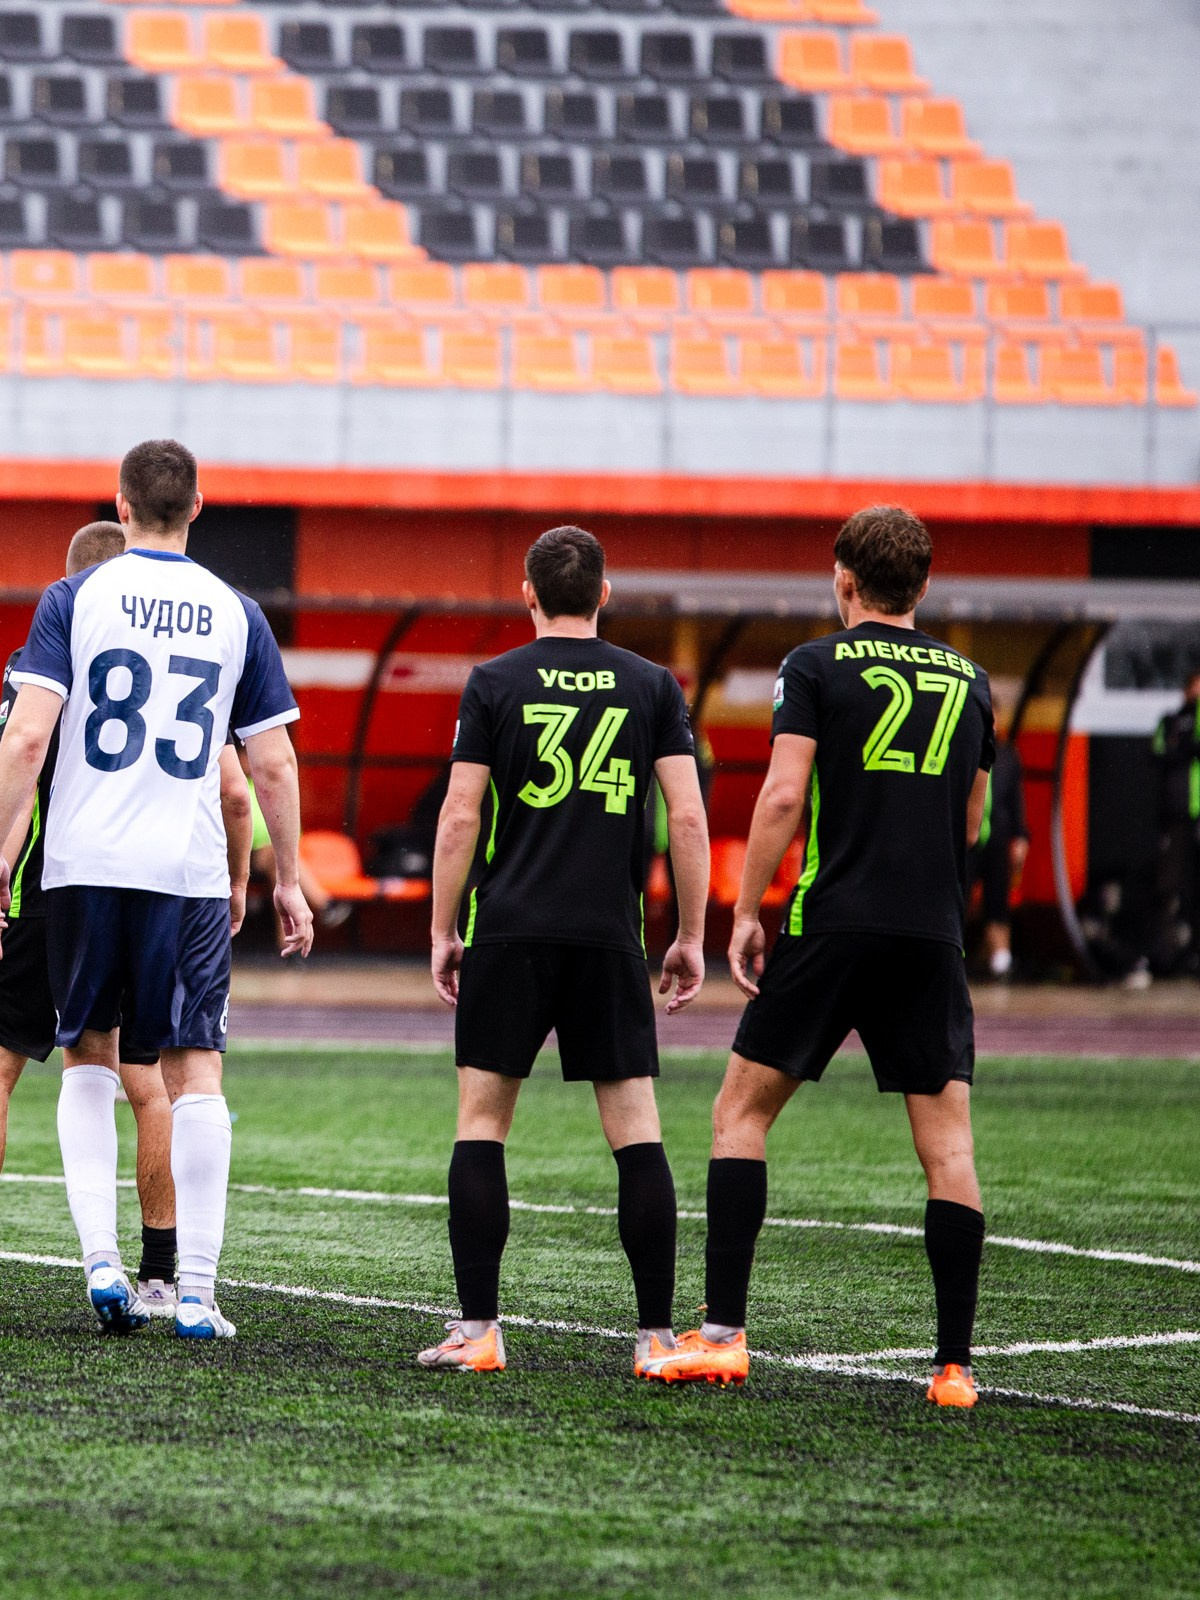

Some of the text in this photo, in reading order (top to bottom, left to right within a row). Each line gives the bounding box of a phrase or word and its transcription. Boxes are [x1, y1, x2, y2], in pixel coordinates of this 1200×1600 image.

[121, 594, 213, 639] ЧУДОВ
[537, 668, 616, 692] УСОВ
[834, 639, 976, 680] АЛЕКСЕЕВ
[84, 648, 222, 780] 83
[860, 665, 969, 776] 27
[517, 703, 636, 815] 34
